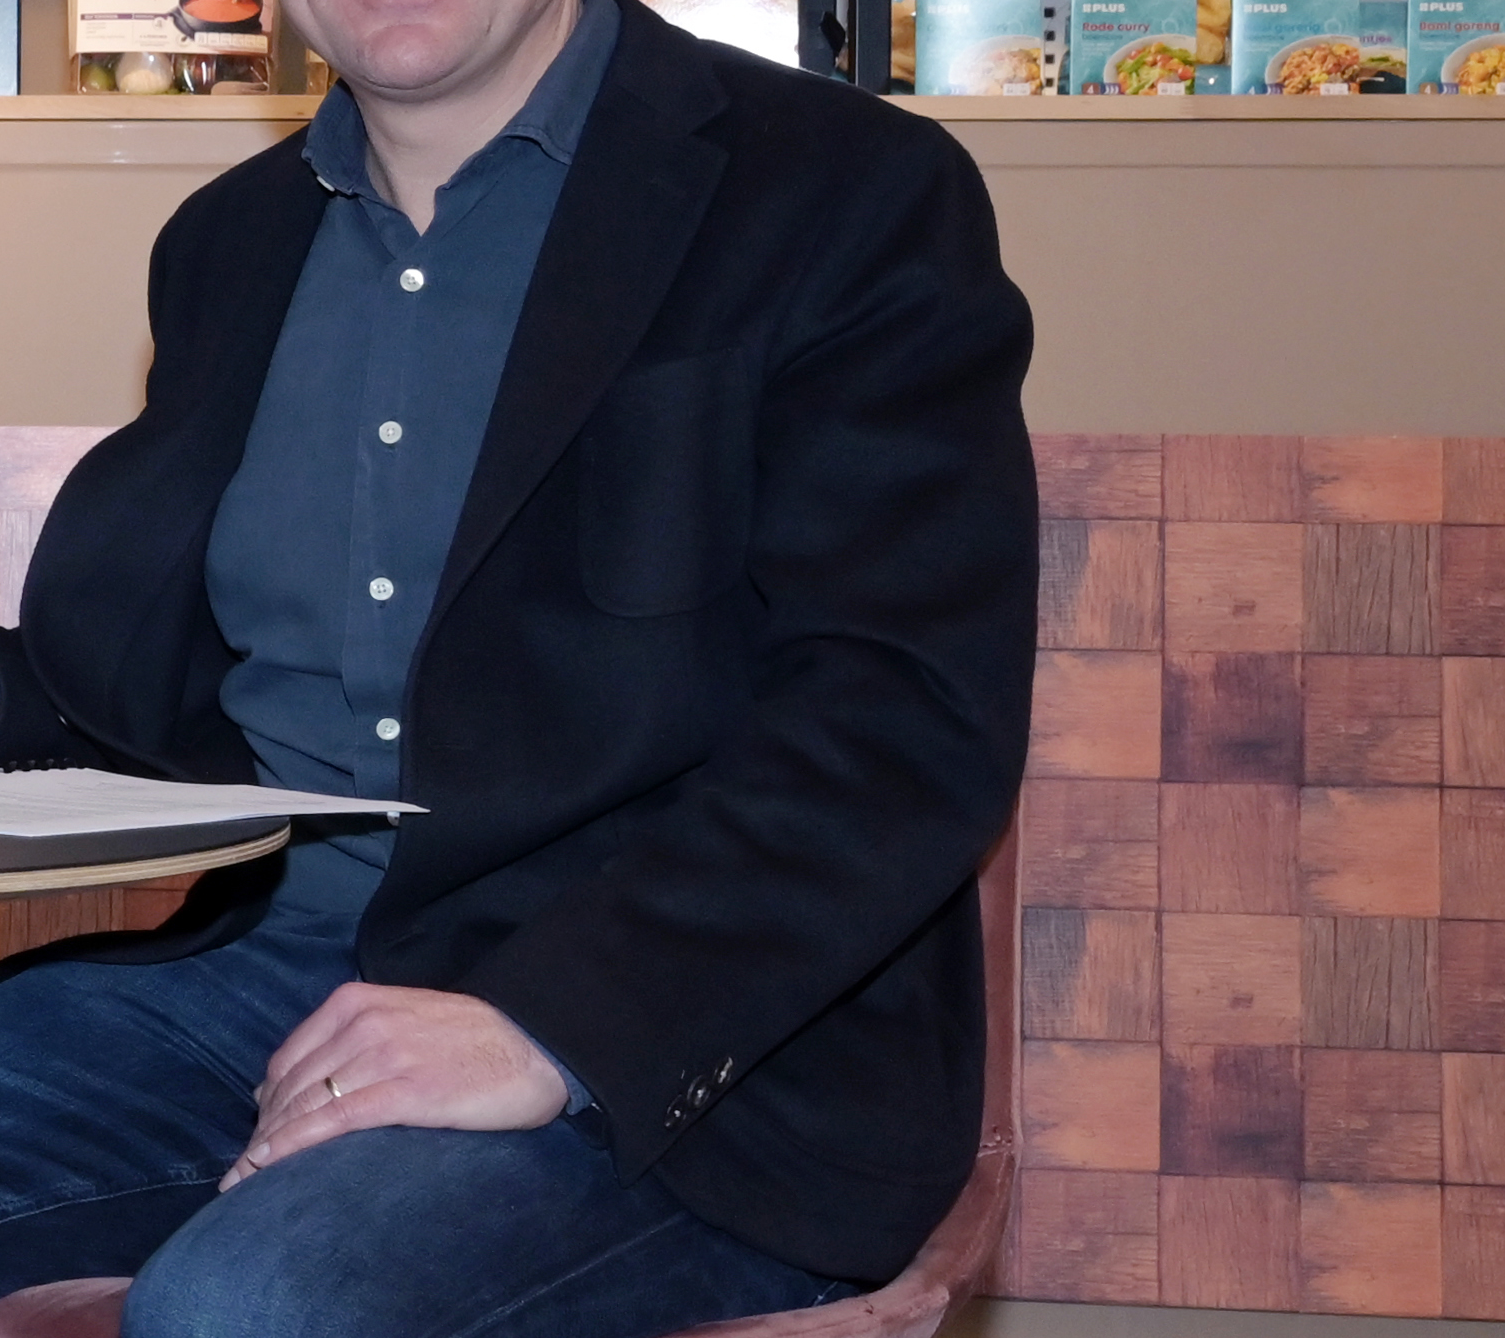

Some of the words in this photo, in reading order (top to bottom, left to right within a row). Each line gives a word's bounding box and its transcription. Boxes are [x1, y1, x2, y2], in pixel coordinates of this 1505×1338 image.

[1083, 22, 1114, 32] Rode
[1117, 23, 1150, 33] curry
[1455, 21, 1500, 33] goreng
